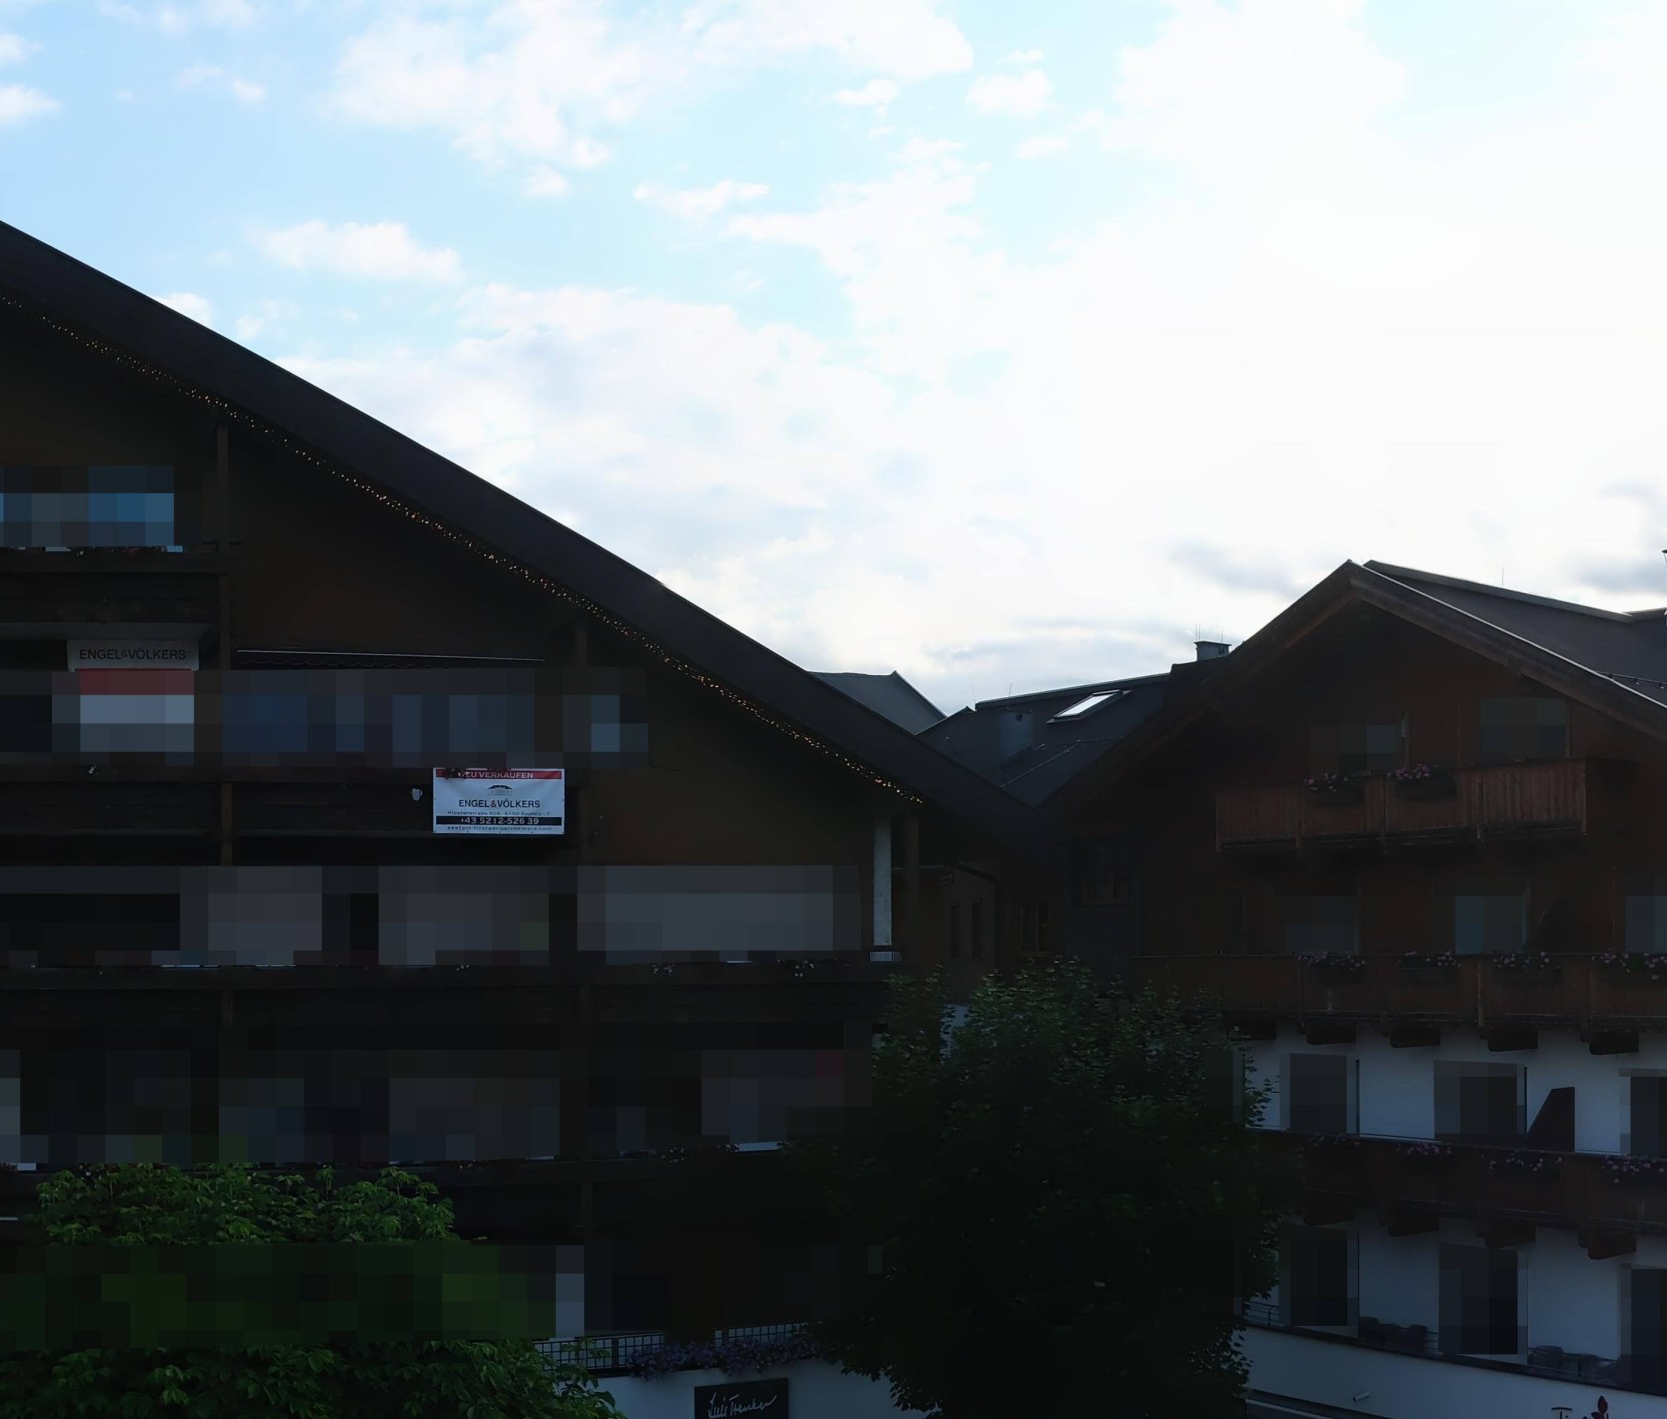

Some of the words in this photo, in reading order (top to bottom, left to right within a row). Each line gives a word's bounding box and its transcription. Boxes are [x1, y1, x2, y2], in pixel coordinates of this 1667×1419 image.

[79, 648, 186, 660] ENGEL&VÖLKERS
[480, 771, 534, 779] VERKAUFEN
[458, 798, 541, 808] ENGEL&VÖLKERS
